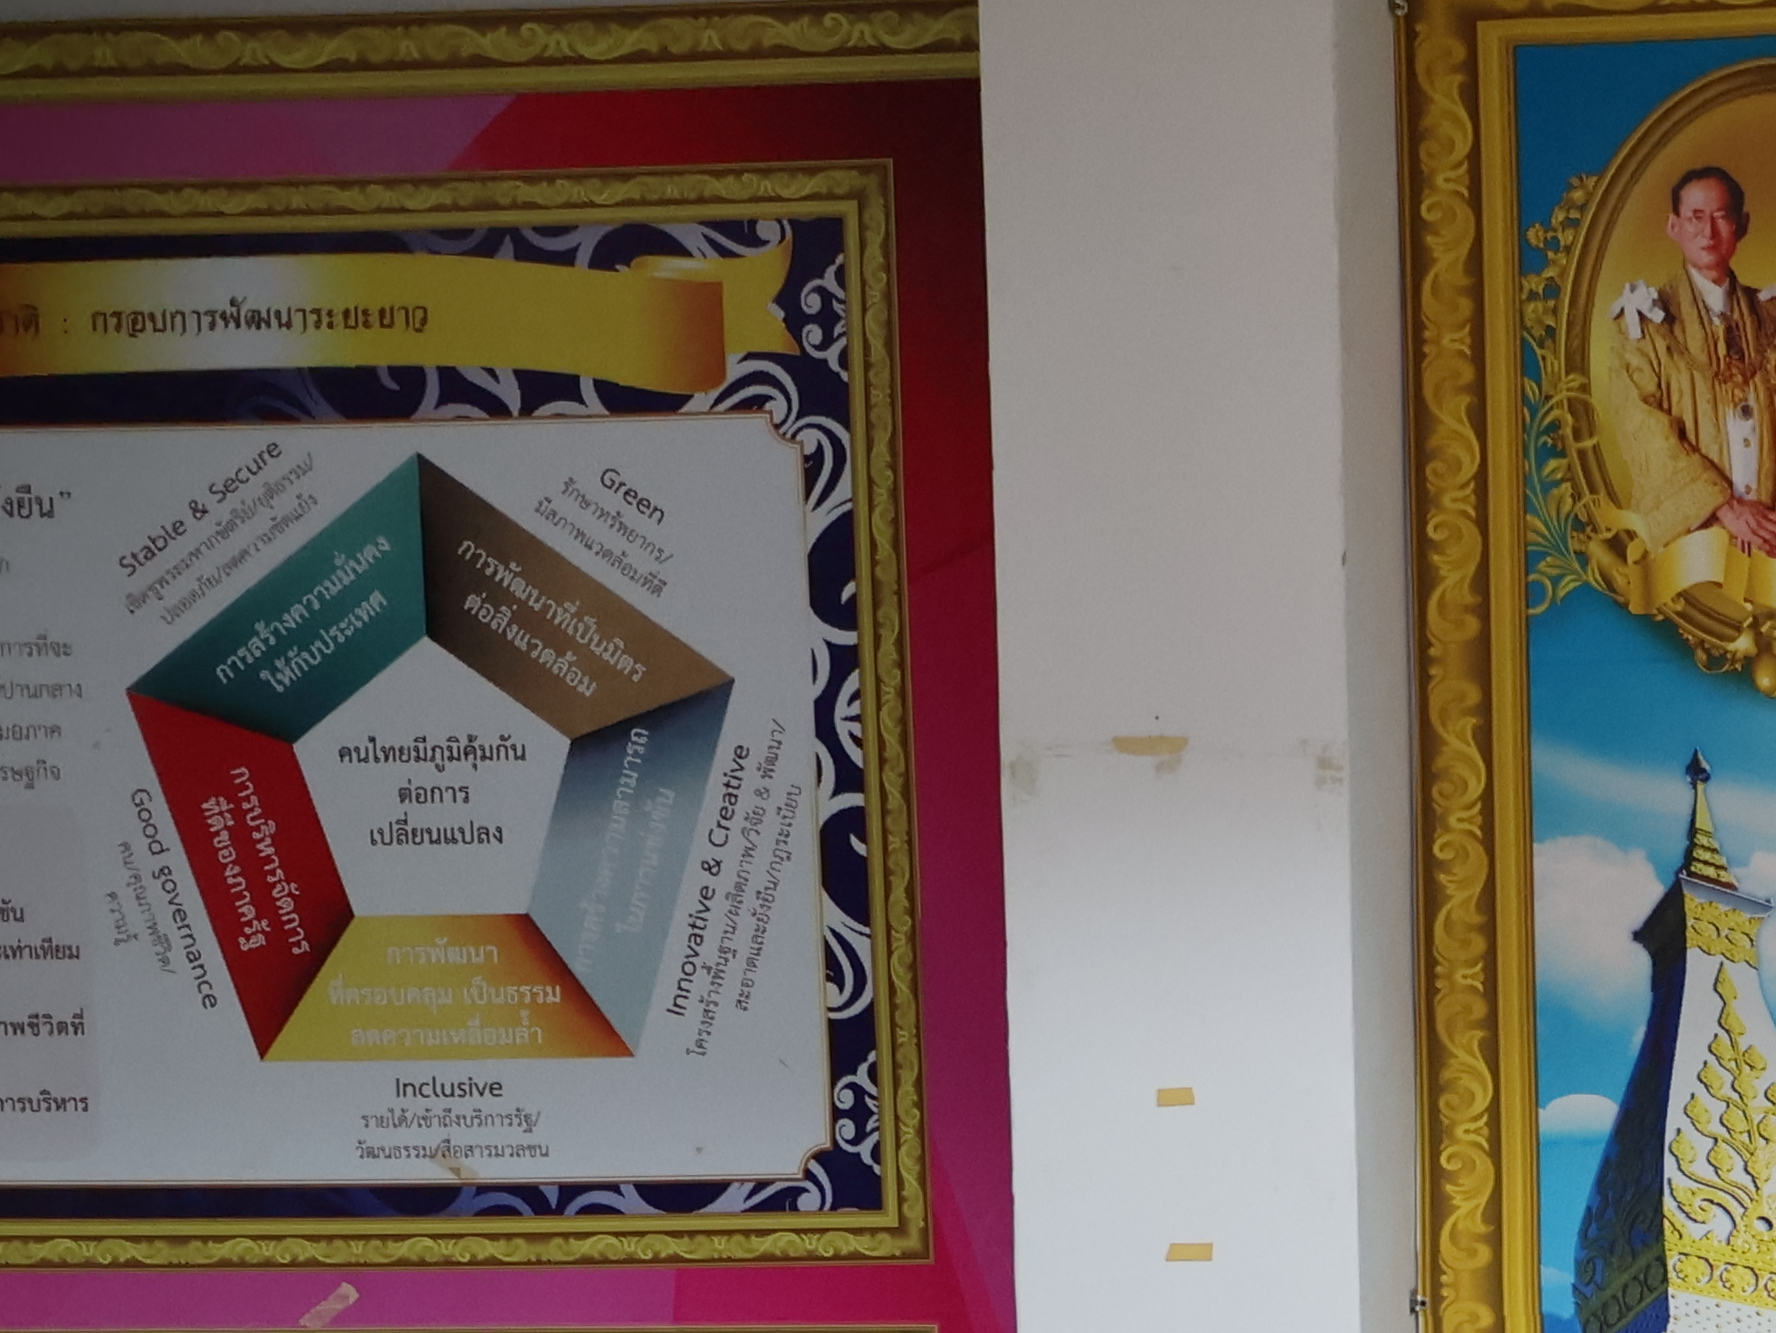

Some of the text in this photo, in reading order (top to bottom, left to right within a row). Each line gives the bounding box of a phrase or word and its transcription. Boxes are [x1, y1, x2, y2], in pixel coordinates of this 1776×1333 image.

[0, 303, 39, 336] าติ
[91, 296, 428, 334] กรอบการพัฒนาระยะยาว
[118, 441, 283, 577] Stable & Secure
[600, 467, 666, 526] Green
[215, 536, 391, 684] การสร้างความมั่นคง
[258, 589, 388, 693] ให้กับประเทศ
[457, 538, 647, 683] การพัฒนาที่เป็นมิตร
[463, 591, 597, 697] ต่อสิ่งแวดล้อม
[337, 734, 527, 773] คนไทยมีภูมิคุ้มกัน
[397, 779, 470, 806] ต่อการ
[230, 765, 311, 955] การบริหารจัดการ
[369, 812, 504, 847] เปลี่ยนแปลง
[130, 787, 219, 1010] Good governance
[201, 796, 271, 951] ที่ดีของภาครัฐ
[666, 744, 751, 1018] Innovative & Creative
[386, 937, 499, 966] การพัฒนา
[463, 975, 561, 1004] เป็นธรรม
[350, 1009, 543, 1048] ลดความเหลื่อมล้ำ
[395, 1076, 504, 1099] Inclusive
